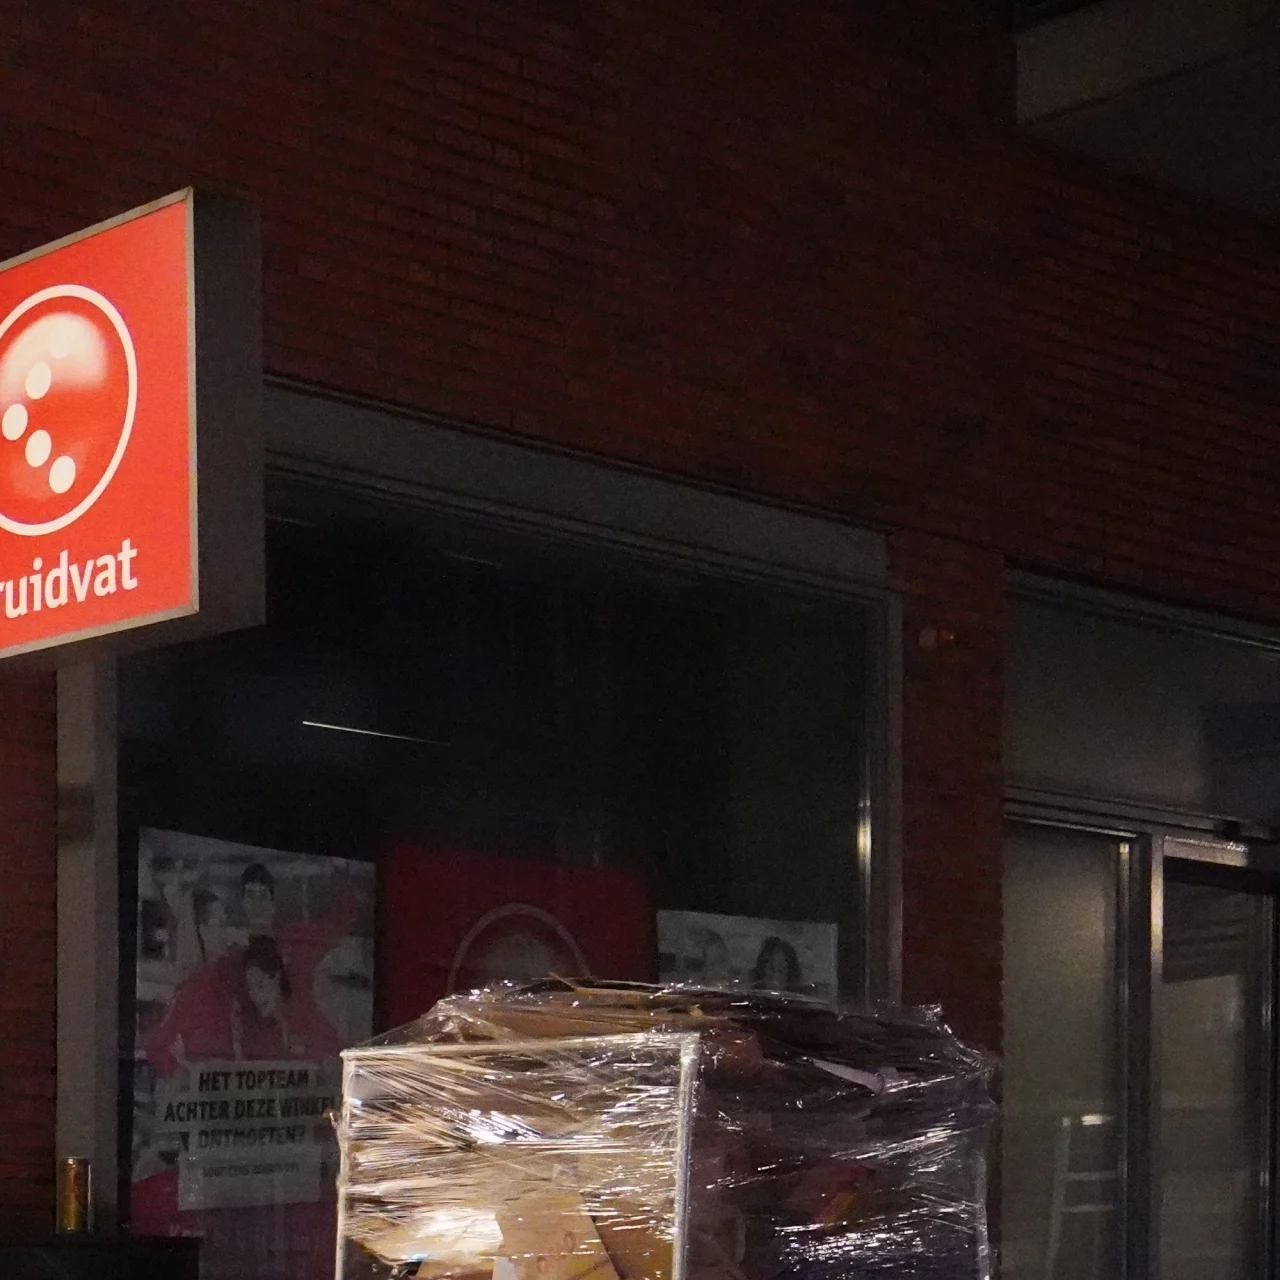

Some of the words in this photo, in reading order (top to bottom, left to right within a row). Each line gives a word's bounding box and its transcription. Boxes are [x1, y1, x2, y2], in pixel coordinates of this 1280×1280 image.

[199, 1072, 232, 1092] HET
[235, 1069, 309, 1091] TOPTEAM
[164, 1101, 230, 1122] ACHTER
[234, 1098, 277, 1120] DEZE
